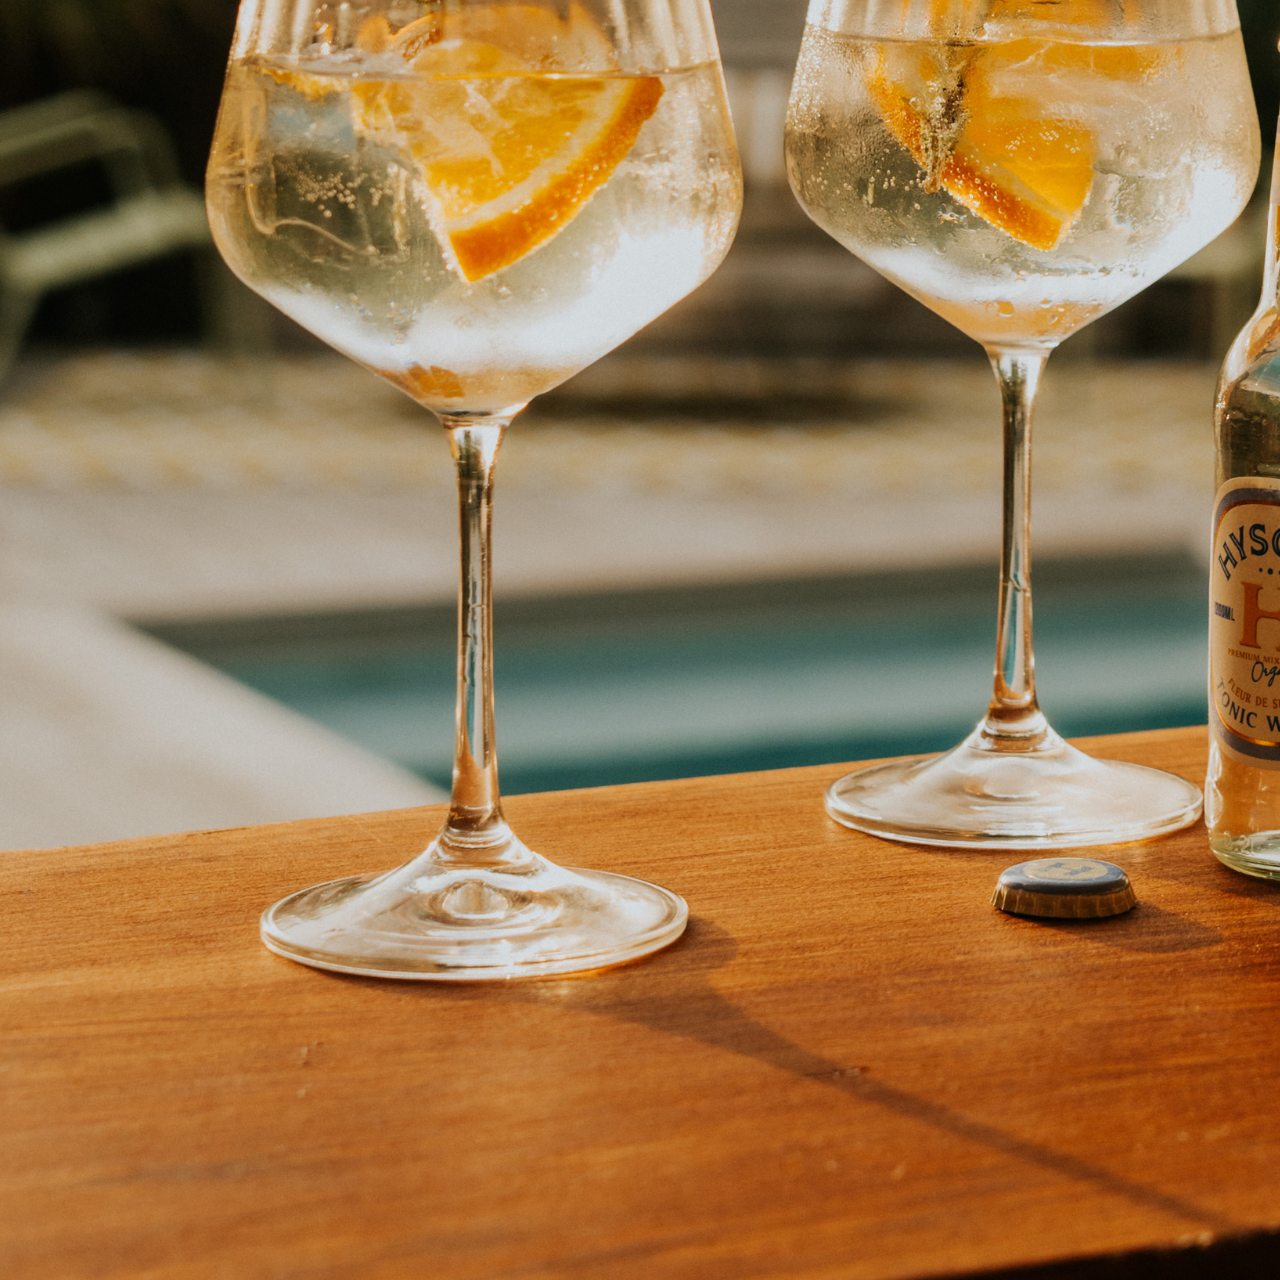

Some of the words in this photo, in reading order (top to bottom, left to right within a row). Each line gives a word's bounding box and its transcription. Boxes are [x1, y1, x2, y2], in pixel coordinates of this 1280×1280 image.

[1228, 648, 1260, 661] PREMIUM
[1217, 677, 1258, 728] TONIC
[1228, 677, 1252, 704] FLEUR
[1255, 696, 1268, 708] DE
